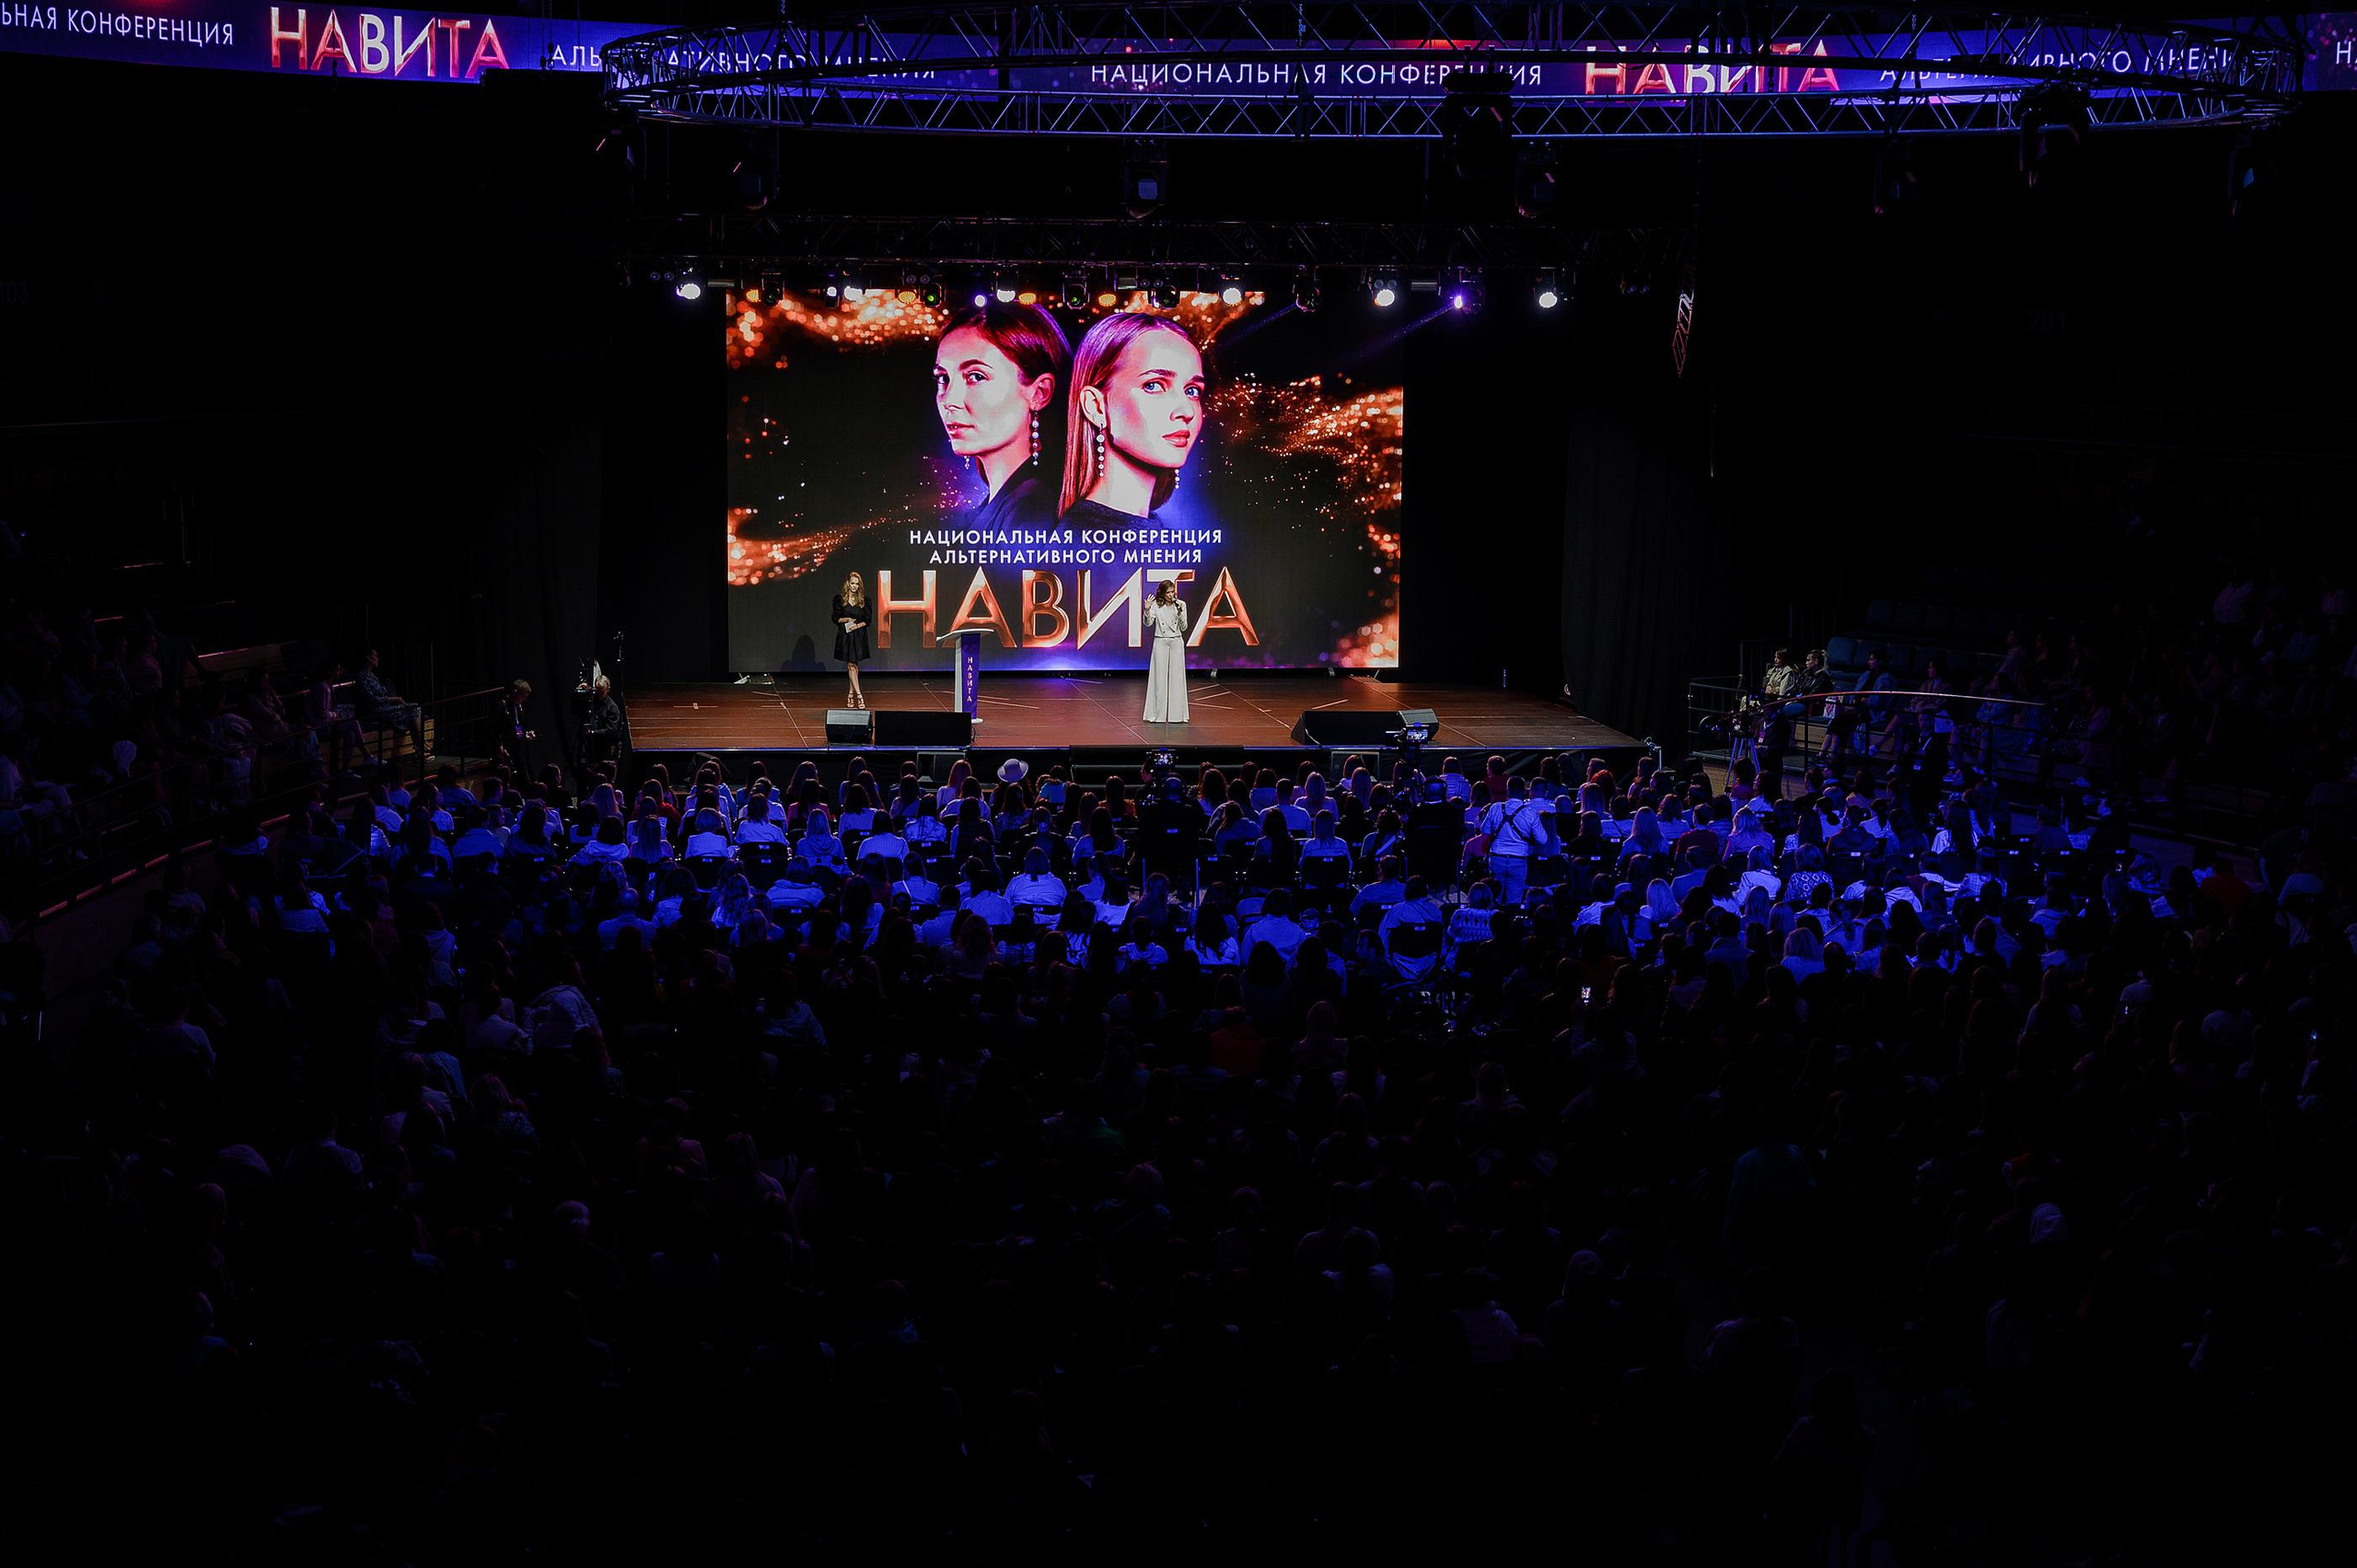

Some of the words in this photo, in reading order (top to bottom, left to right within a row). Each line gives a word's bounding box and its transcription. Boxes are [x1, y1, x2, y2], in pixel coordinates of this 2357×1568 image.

[2, 2, 57, 29] ЬНАЯ
[68, 8, 235, 48] КОНФЕРЕНЦИЯ
[270, 6, 510, 79] НАВИТА
[1091, 64, 1326, 86] НАЦИОНАЛЬНАЯ
[1341, 64, 1541, 86] КОНФЕРИЯ
[910, 529, 1074, 547] НАЦИОНАЛЬНАЯ
[1082, 528, 1223, 546] КОНФЕРЕНЦИЯ
[929, 549, 1116, 564] АЛЬТЕРНАТИВНОГО
[1124, 549, 1202, 563] МНЕНИЯ
[877, 565, 1260, 650] НАВИТА
